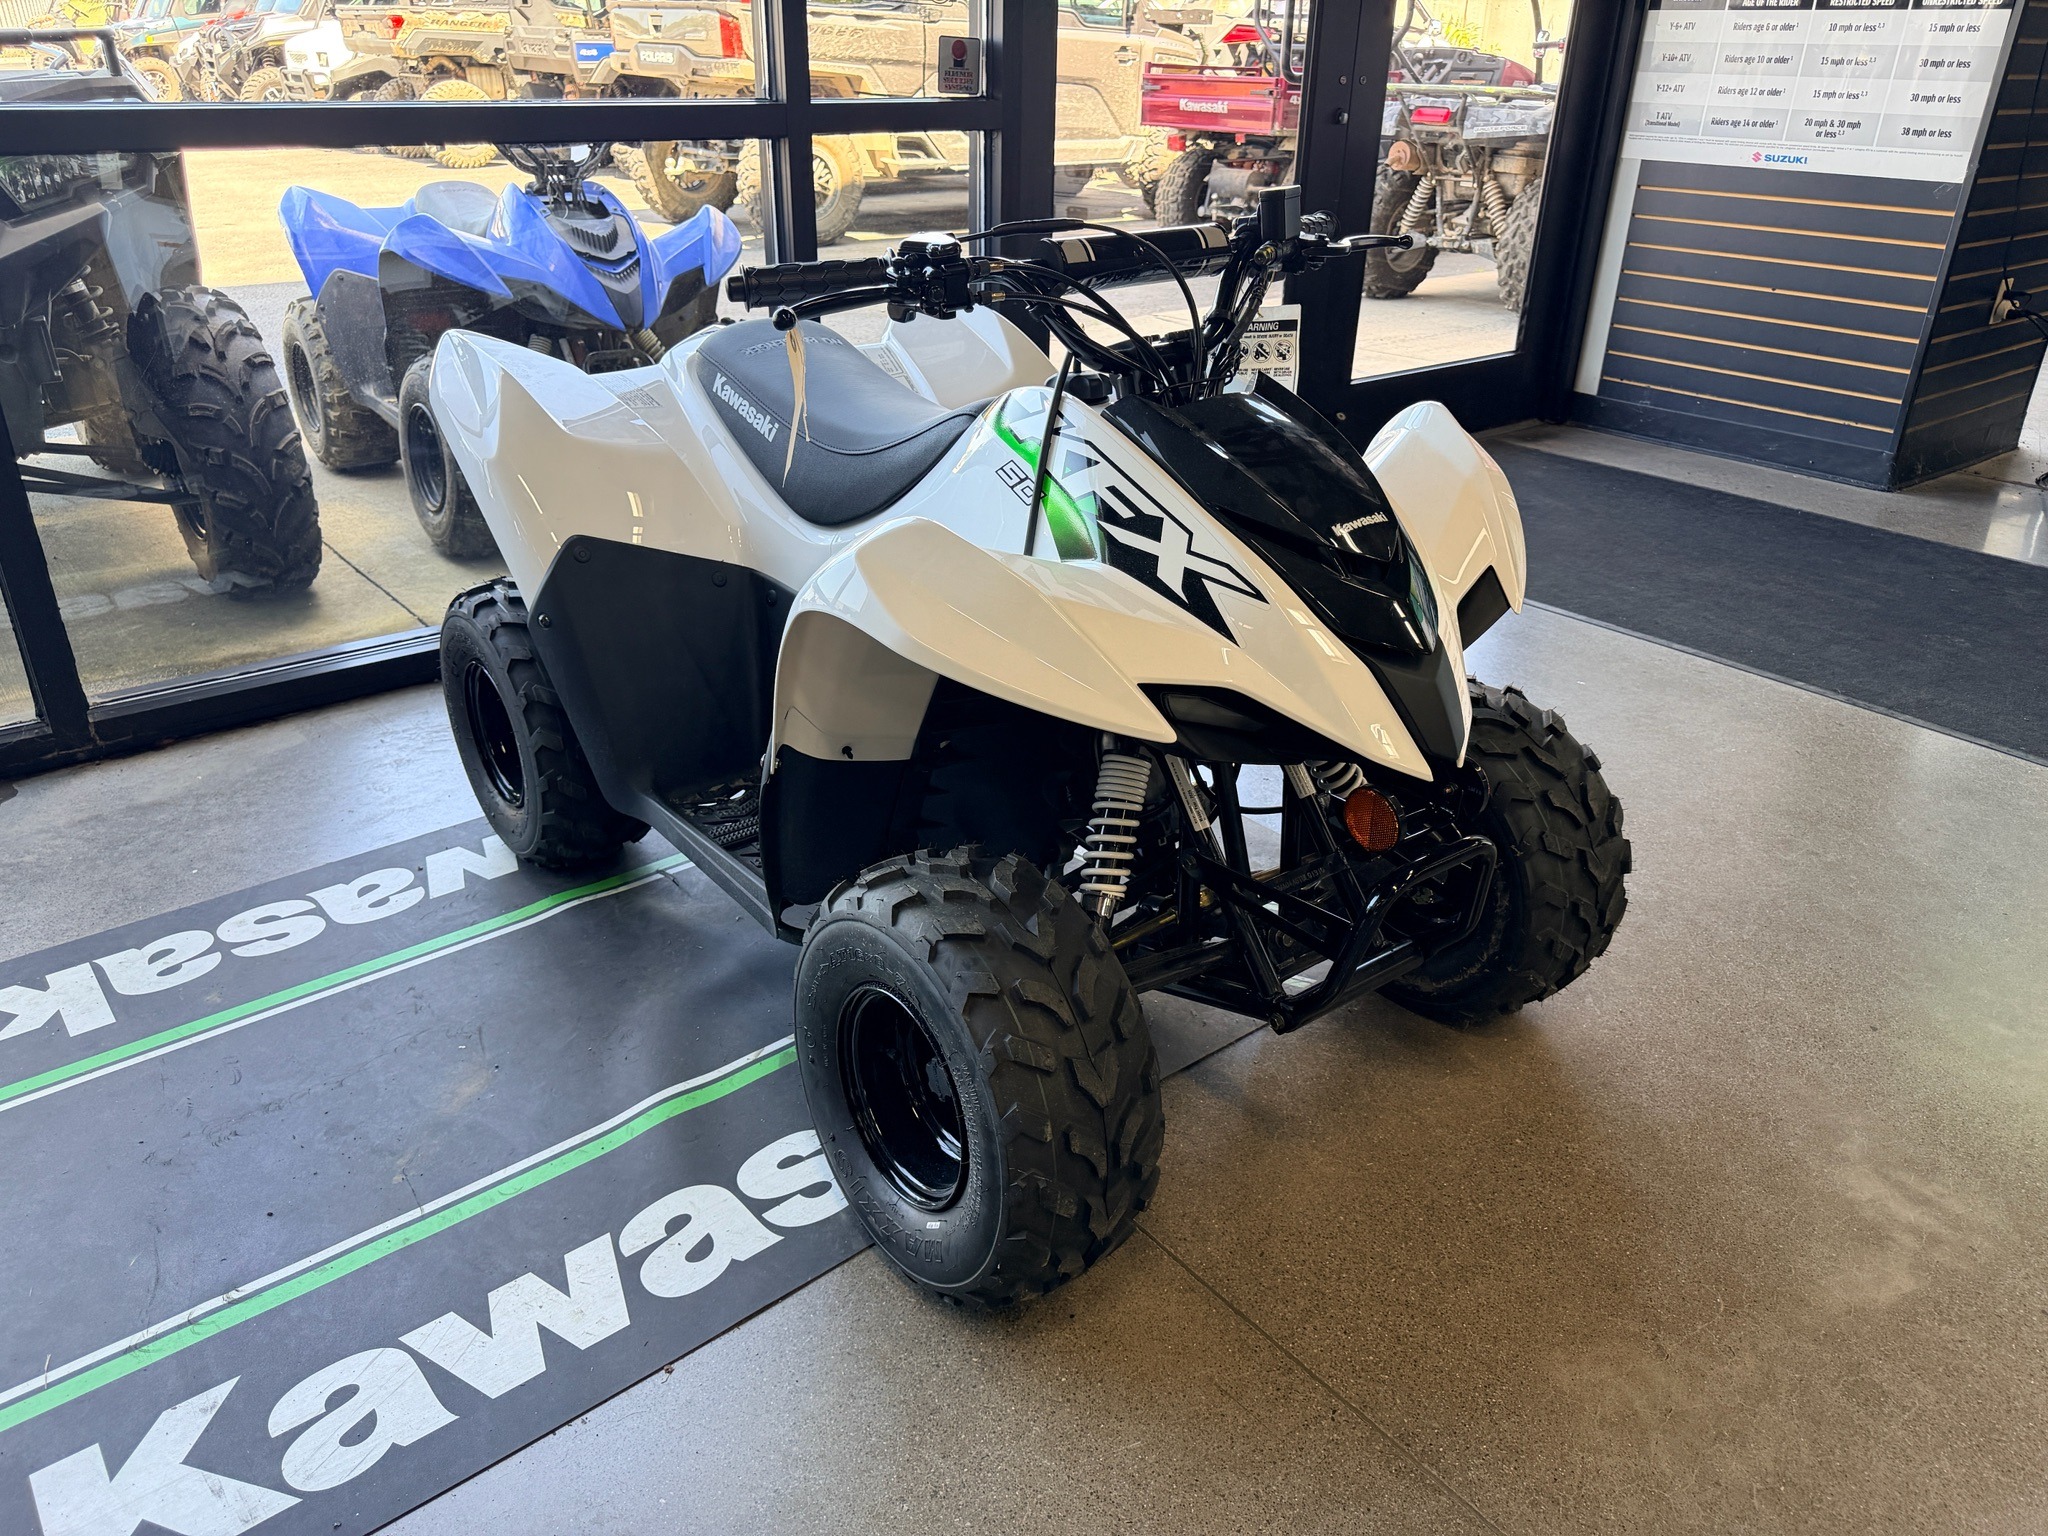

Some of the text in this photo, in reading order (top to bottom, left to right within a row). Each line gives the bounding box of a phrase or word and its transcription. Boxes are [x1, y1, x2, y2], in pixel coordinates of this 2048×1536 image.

[430, 20, 490, 28] RANGER
[1684, 22, 1696, 30] ATV
[1733, 23, 1752, 31] Riders
[1753, 25, 1765, 33] age
[1828, 23, 1837, 31] 10
[1838, 24, 1853, 33] mph
[1928, 23, 1937, 32] 15
[1939, 24, 1955, 34] mph
[1966, 24, 1981, 32] less
[640, 50, 674, 64] POLARIS
[1679, 54, 1691, 62] ATV
[1725, 55, 1743, 63] Riders
[1744, 57, 1756, 65] age
[1820, 56, 1829, 65] 15
[1830, 57, 1845, 66] mph
[1919, 59, 1928, 67] 30
[1930, 59, 1945, 69] mph
[1956, 60, 1971, 68] less
[1673, 85, 1685, 93] ATV
[1718, 86, 1736, 95] Riders
[1738, 88, 1749, 96] age
[1812, 90, 1821, 98] 15
[1822, 91, 1836, 100] mph
[1910, 94, 1919, 102] 30
[1921, 94, 1936, 104] mph
[1947, 94, 1961, 103] less
[1179, 98, 1228, 114] Kawasaki
[1711, 117, 1729, 126] Riders
[1730, 120, 1741, 128] age
[1805, 118, 1861, 130] 20 mph & 30 mph
[1901, 127, 1910, 136] 38
[1911, 128, 1927, 138] mph
[1937, 128, 1952, 138] less
[1764, 154, 1808, 164] SUZUKI
[1247, 322, 1279, 331] ARNING
[712, 373, 779, 442] Kawasaki
[1331, 511, 1389, 536] Kawasaki
[834, 1150, 942, 1262] MAXXIS
